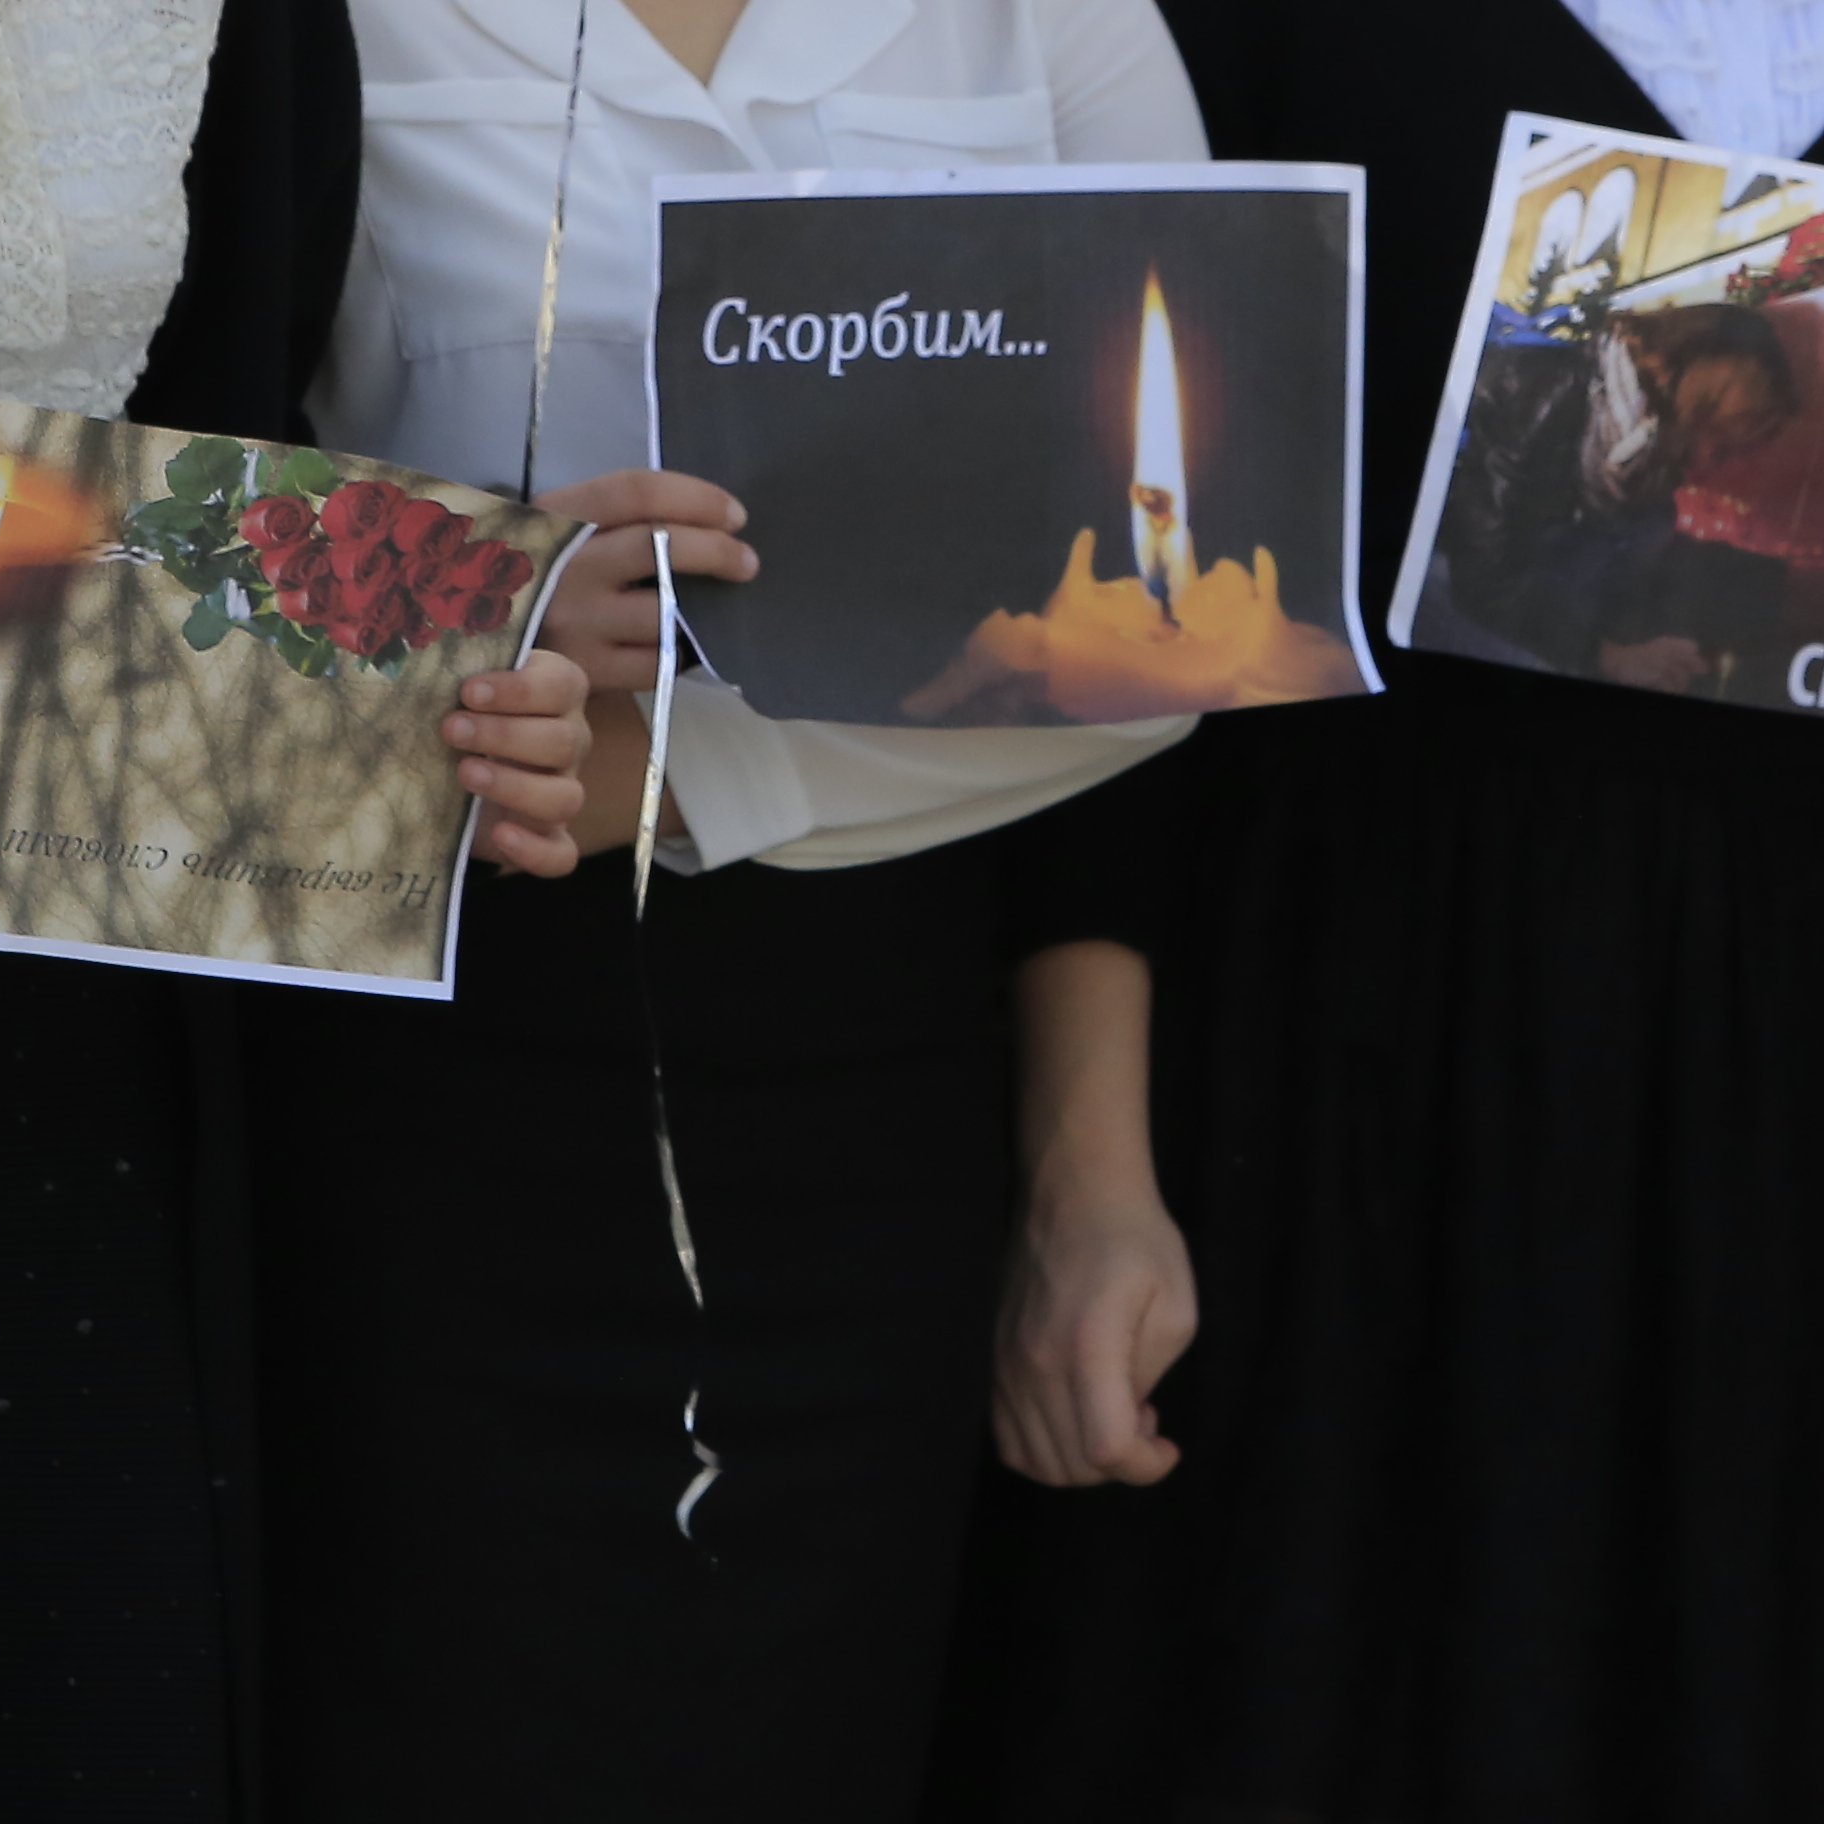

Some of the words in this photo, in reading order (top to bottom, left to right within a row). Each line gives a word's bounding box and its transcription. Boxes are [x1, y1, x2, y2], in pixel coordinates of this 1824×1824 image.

[702, 291, 1048, 376] Скорбим...
[3, 828, 170, 873] словами
[182, 852, 373, 895] выразить
[382, 869, 438, 909] Не
